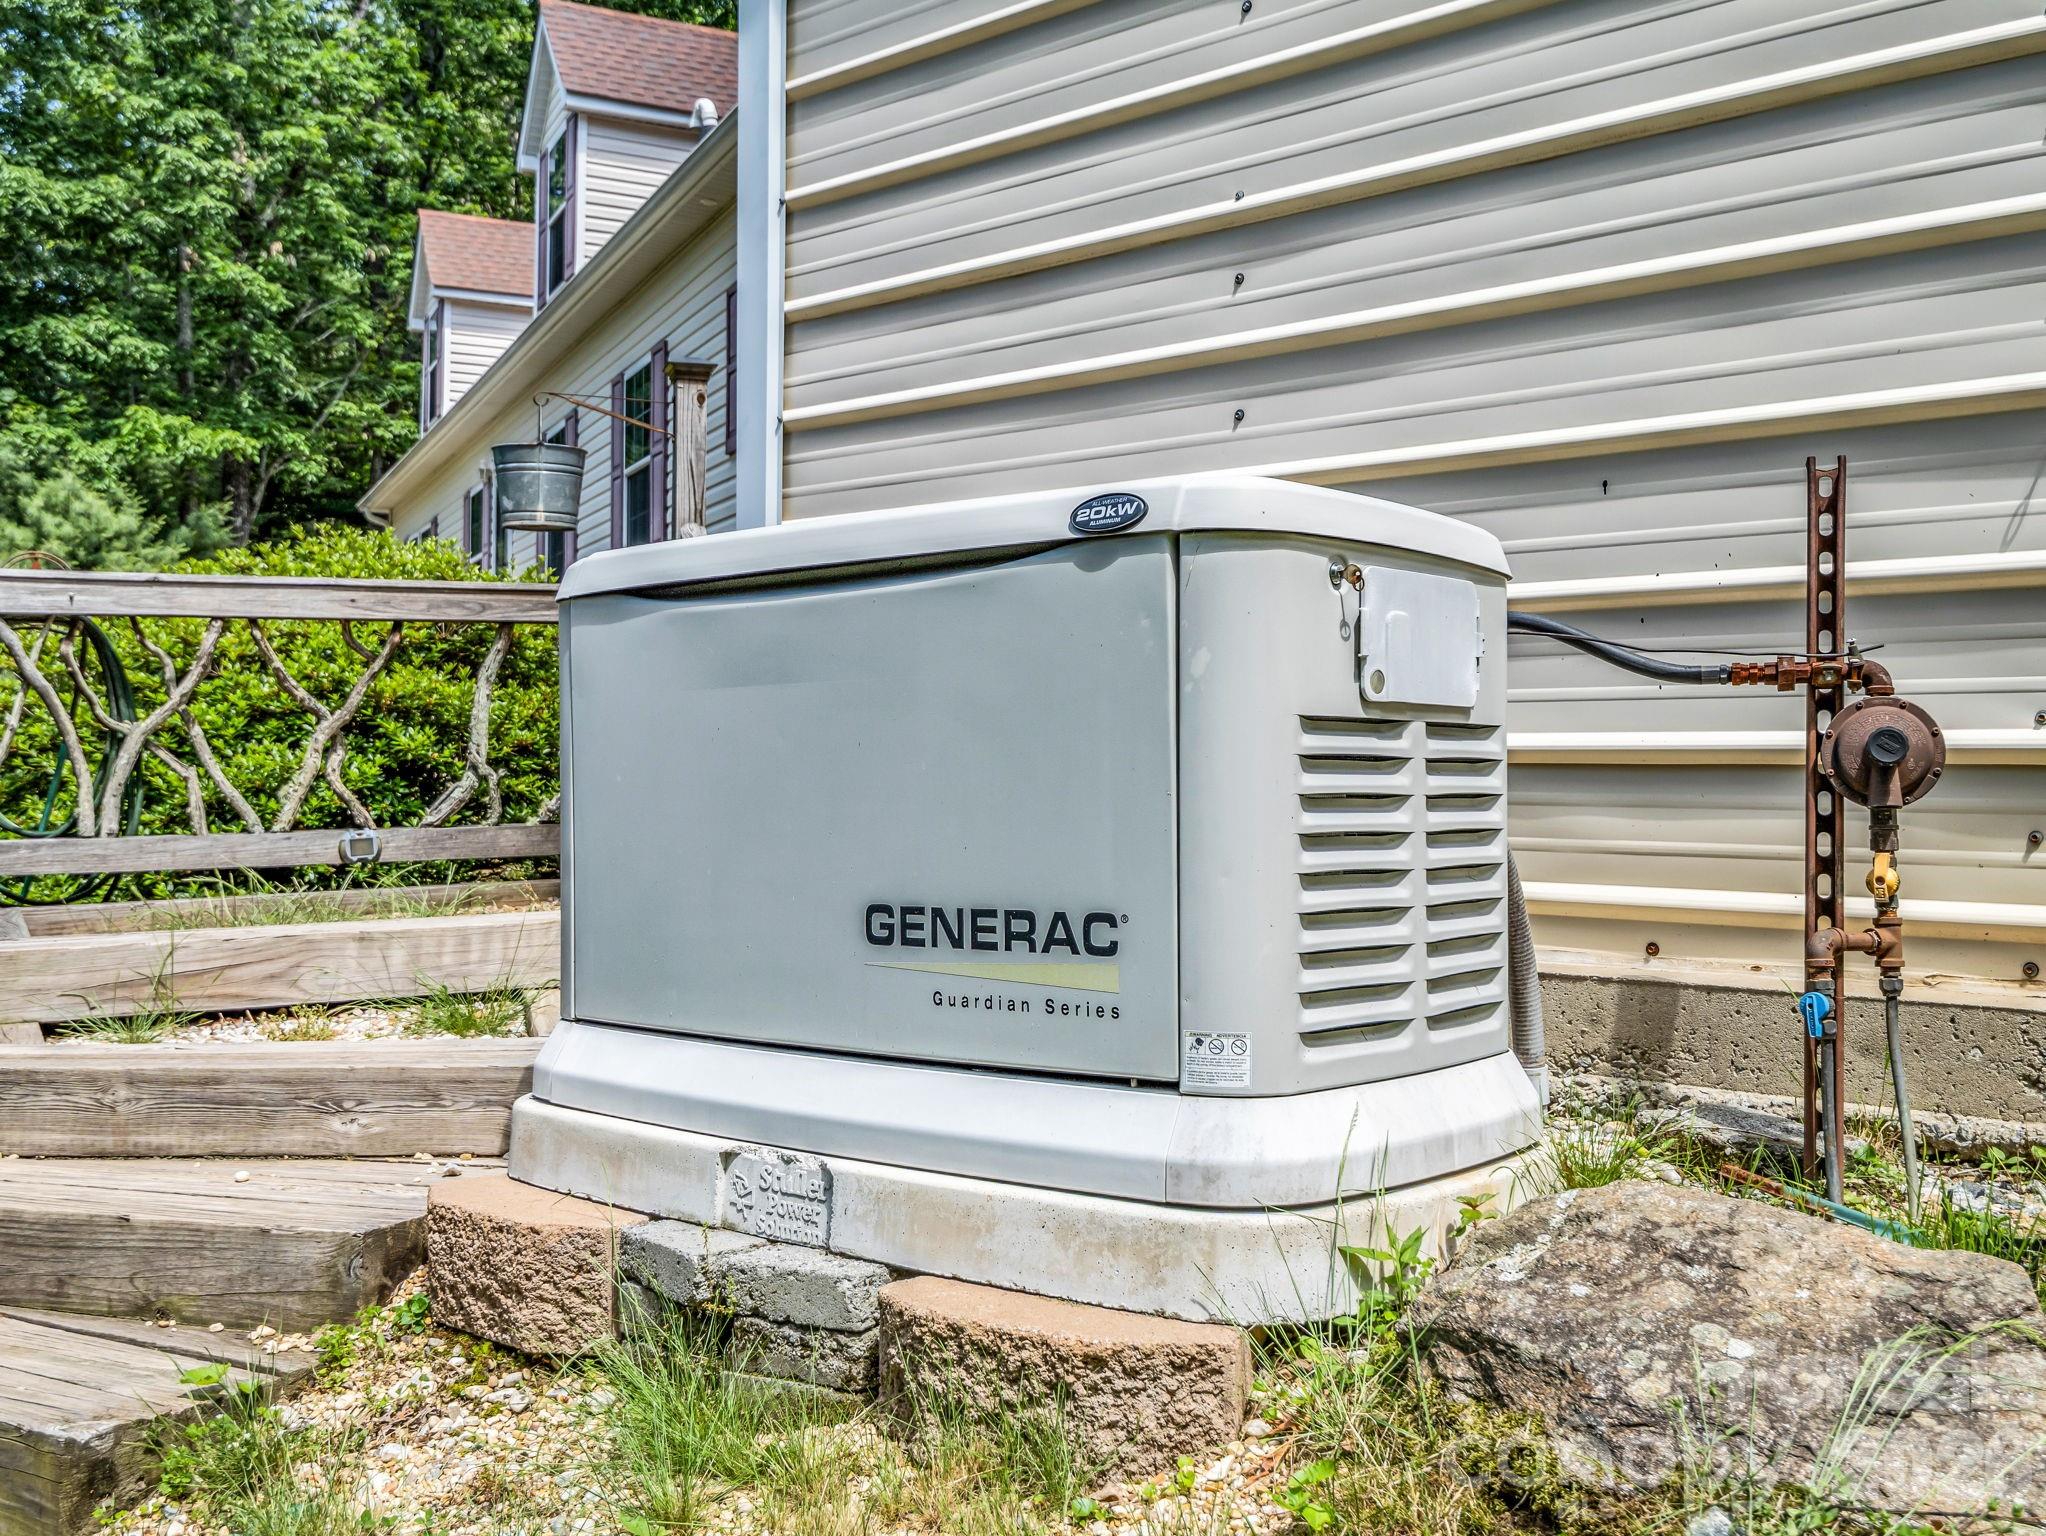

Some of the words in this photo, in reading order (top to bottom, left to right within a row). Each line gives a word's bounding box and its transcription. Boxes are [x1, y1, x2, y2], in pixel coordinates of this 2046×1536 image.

[1076, 502, 1138, 522] 20kW
[1090, 517, 1121, 526] ALUMINUM
[933, 990, 1030, 1013] Guardian
[1045, 998, 1121, 1020] Series
